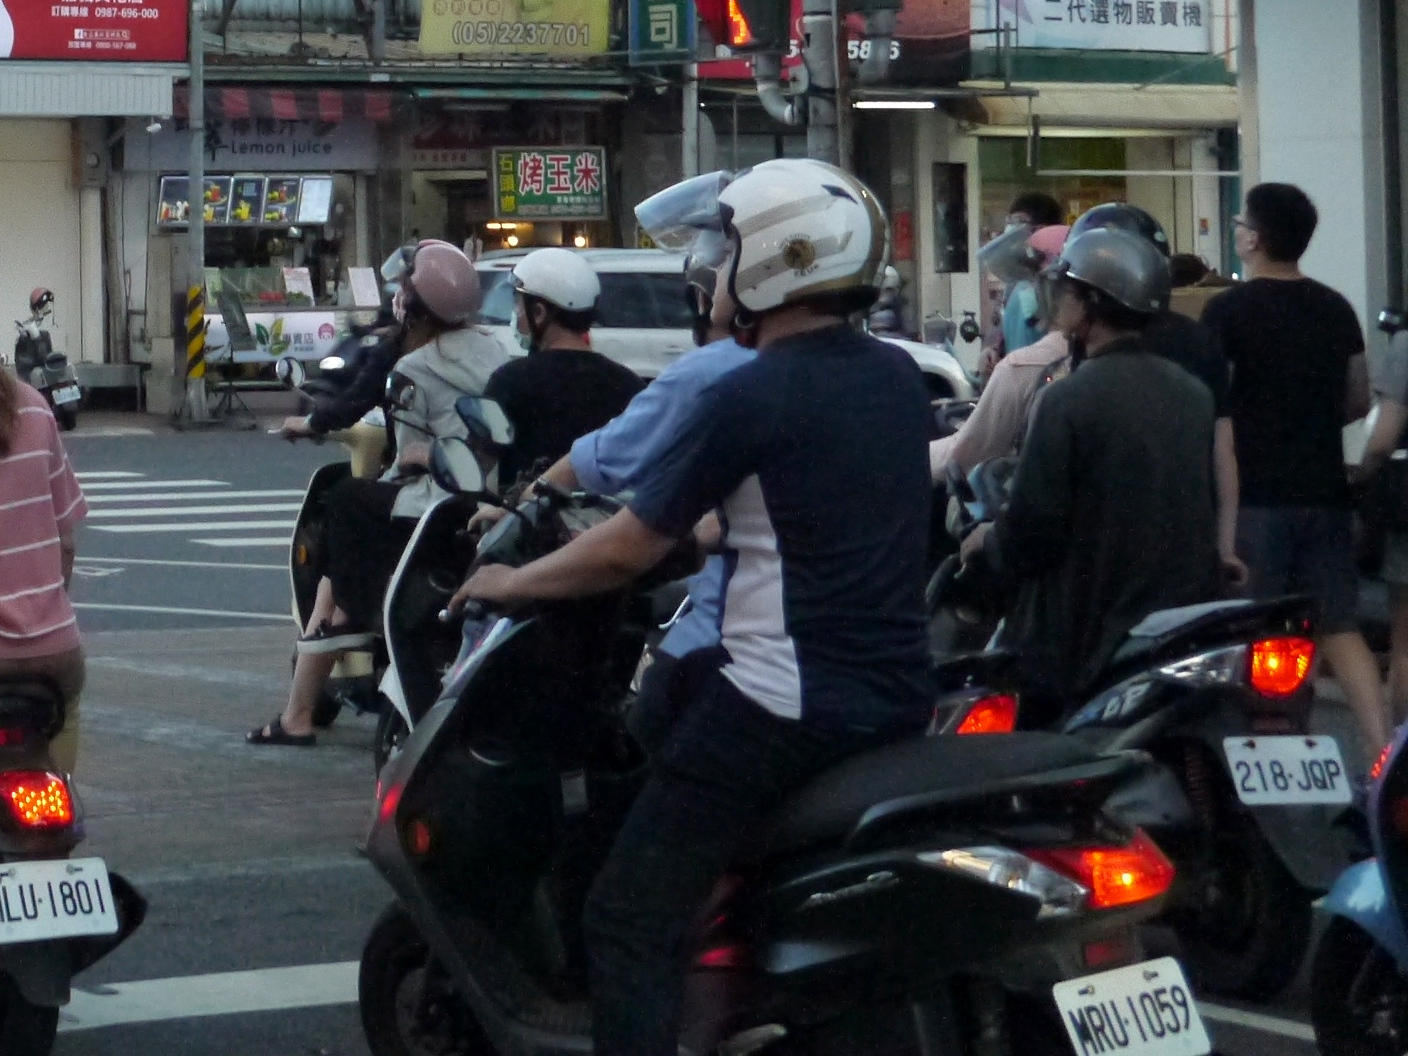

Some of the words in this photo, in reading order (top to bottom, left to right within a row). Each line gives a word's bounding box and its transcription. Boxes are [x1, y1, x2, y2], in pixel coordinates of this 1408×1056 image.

[452, 21, 590, 45] (05)2237701
[232, 140, 285, 154] Lemon
[293, 139, 333, 157] juice
[518, 152, 600, 196] 烤玉米
